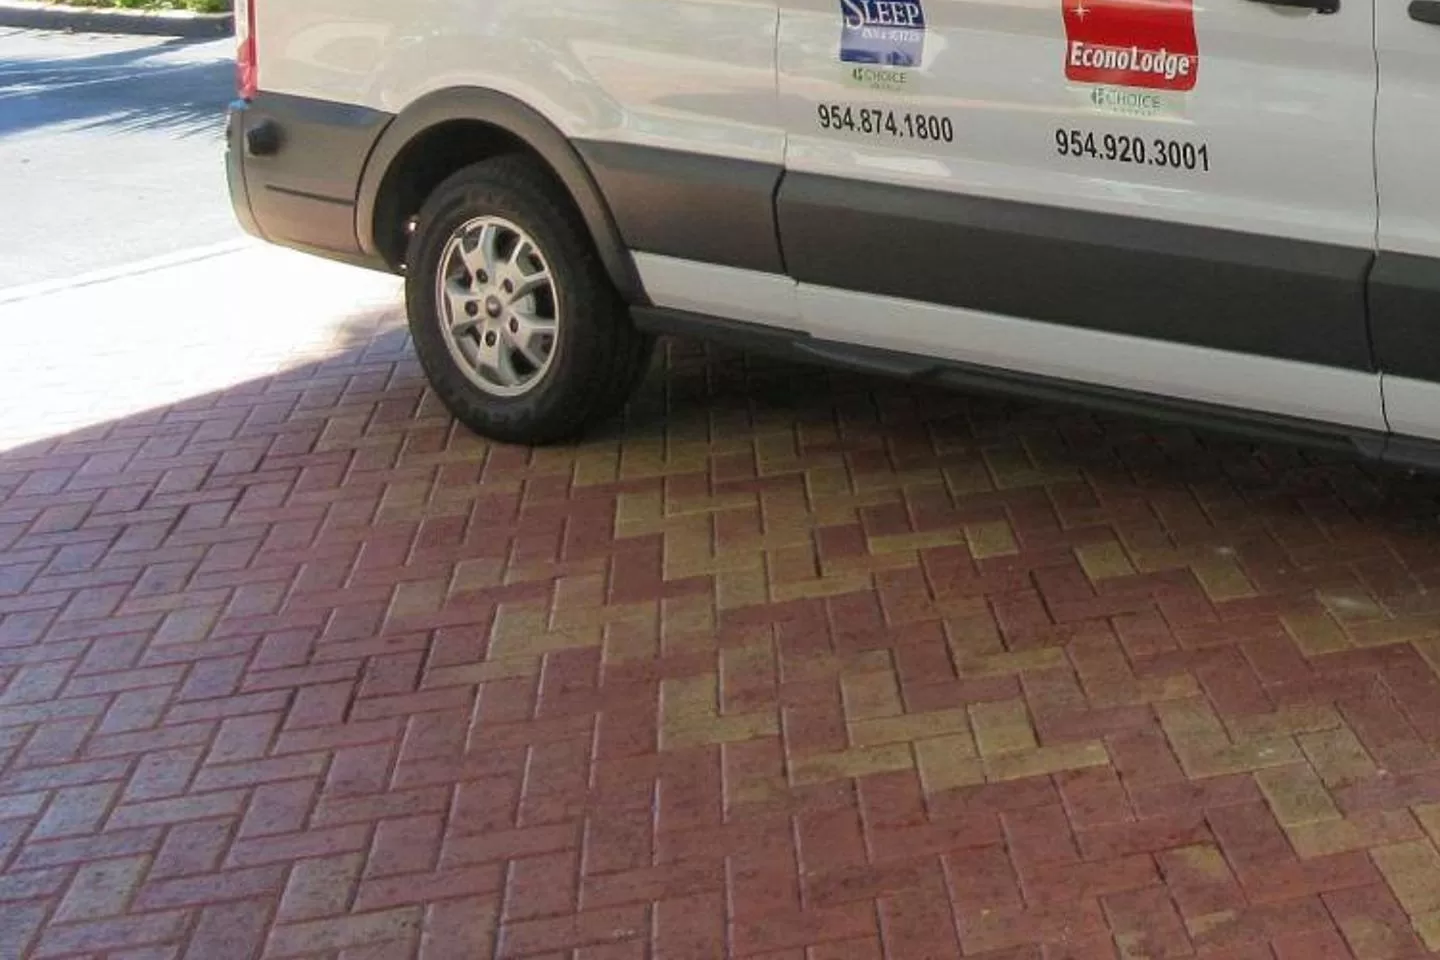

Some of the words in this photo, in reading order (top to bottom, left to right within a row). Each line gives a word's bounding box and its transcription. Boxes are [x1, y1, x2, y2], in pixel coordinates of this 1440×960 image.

[1070, 40, 1190, 80] EconoLodge
[1106, 90, 1161, 109] CHOICE
[817, 103, 954, 142] 954.874.1800
[1055, 128, 1209, 172] 954.920.3001
